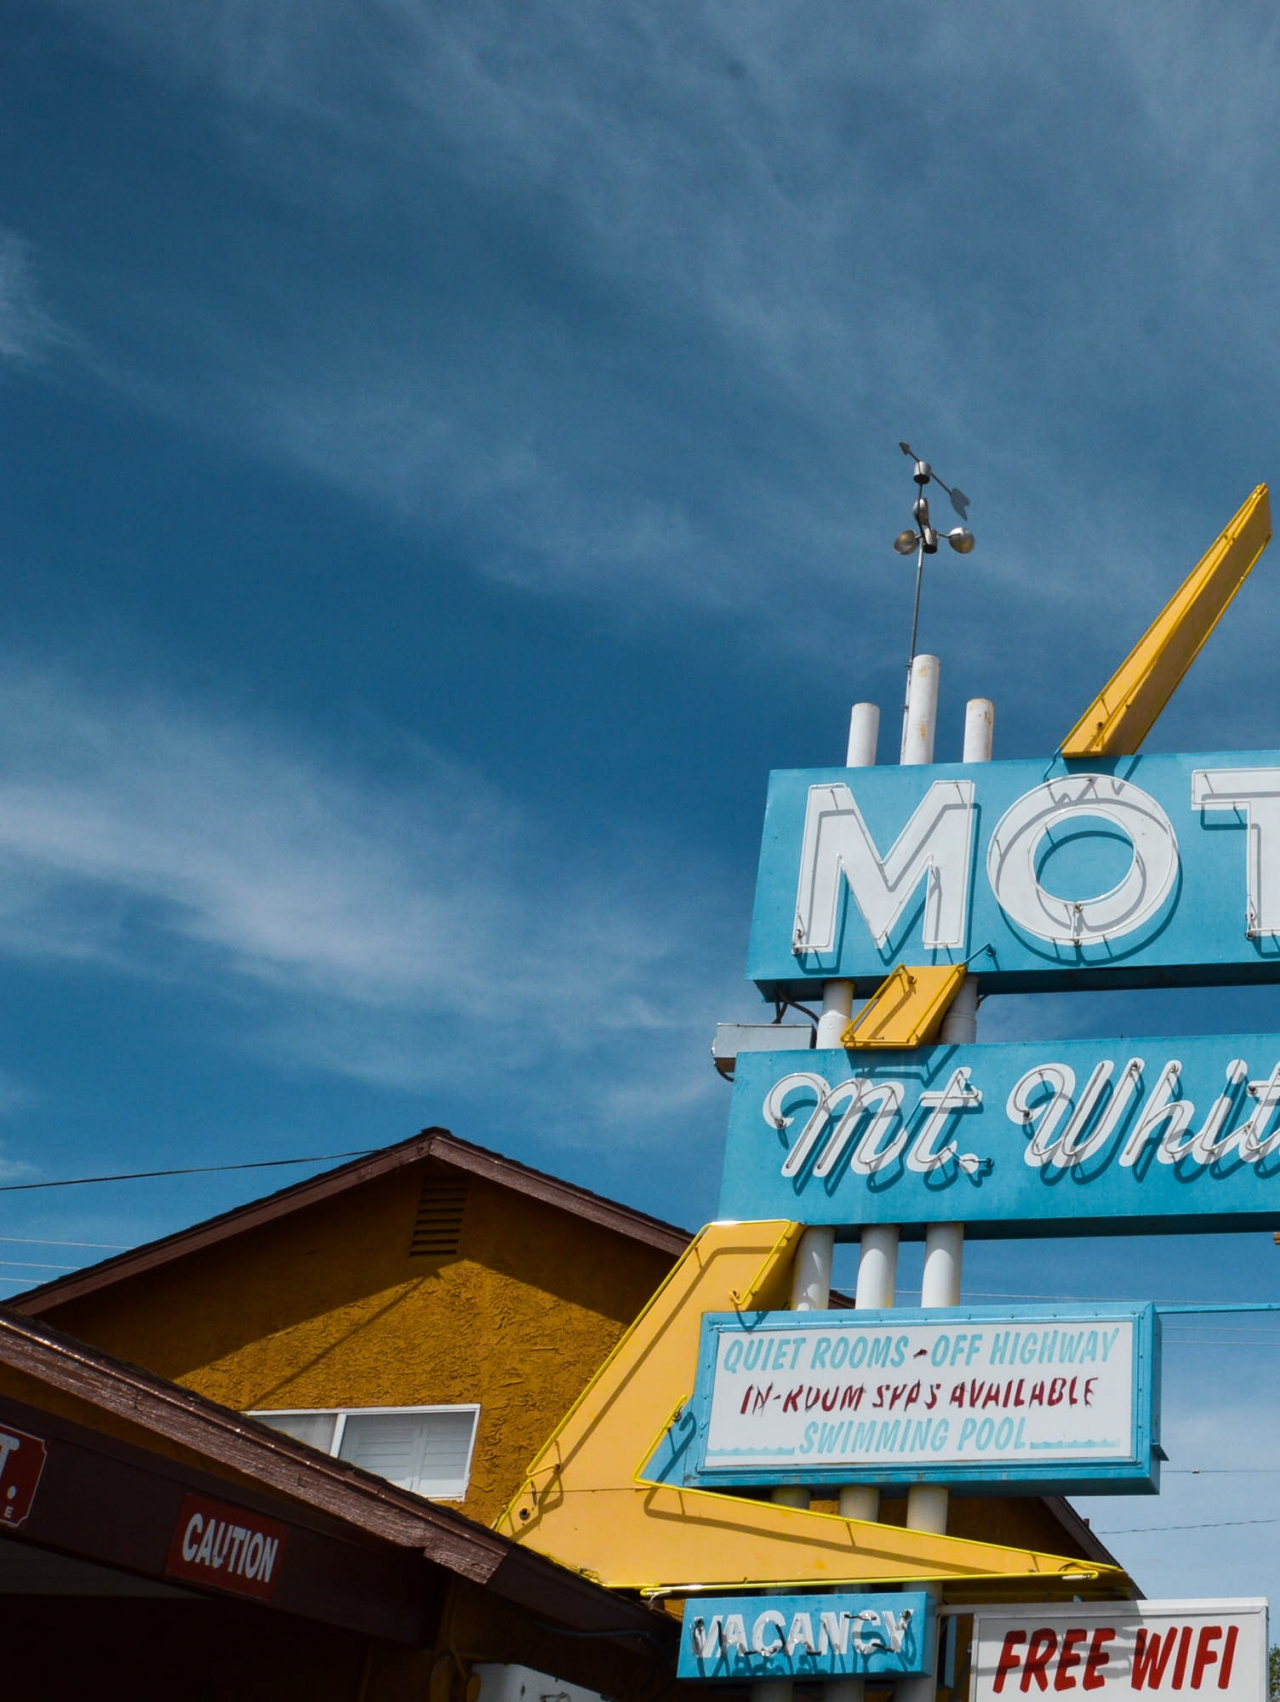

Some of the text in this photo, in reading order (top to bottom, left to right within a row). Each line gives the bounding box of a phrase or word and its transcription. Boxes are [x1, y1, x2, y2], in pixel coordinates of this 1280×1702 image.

[762, 1066, 990, 1176] Mt.
[723, 1337, 807, 1374] QUIET
[810, 1335, 909, 1370] ROOMS
[931, 1333, 983, 1368] OFF
[989, 1328, 1120, 1365] HIGHWAY
[949, 1376, 1099, 1408] AVAILABLE
[799, 1416, 1027, 1455] SWIMMING POOL
[182, 1512, 279, 1583] CAUTION
[691, 1608, 914, 1659] VACANCY
[993, 1624, 1239, 1693] FREE WIFI
